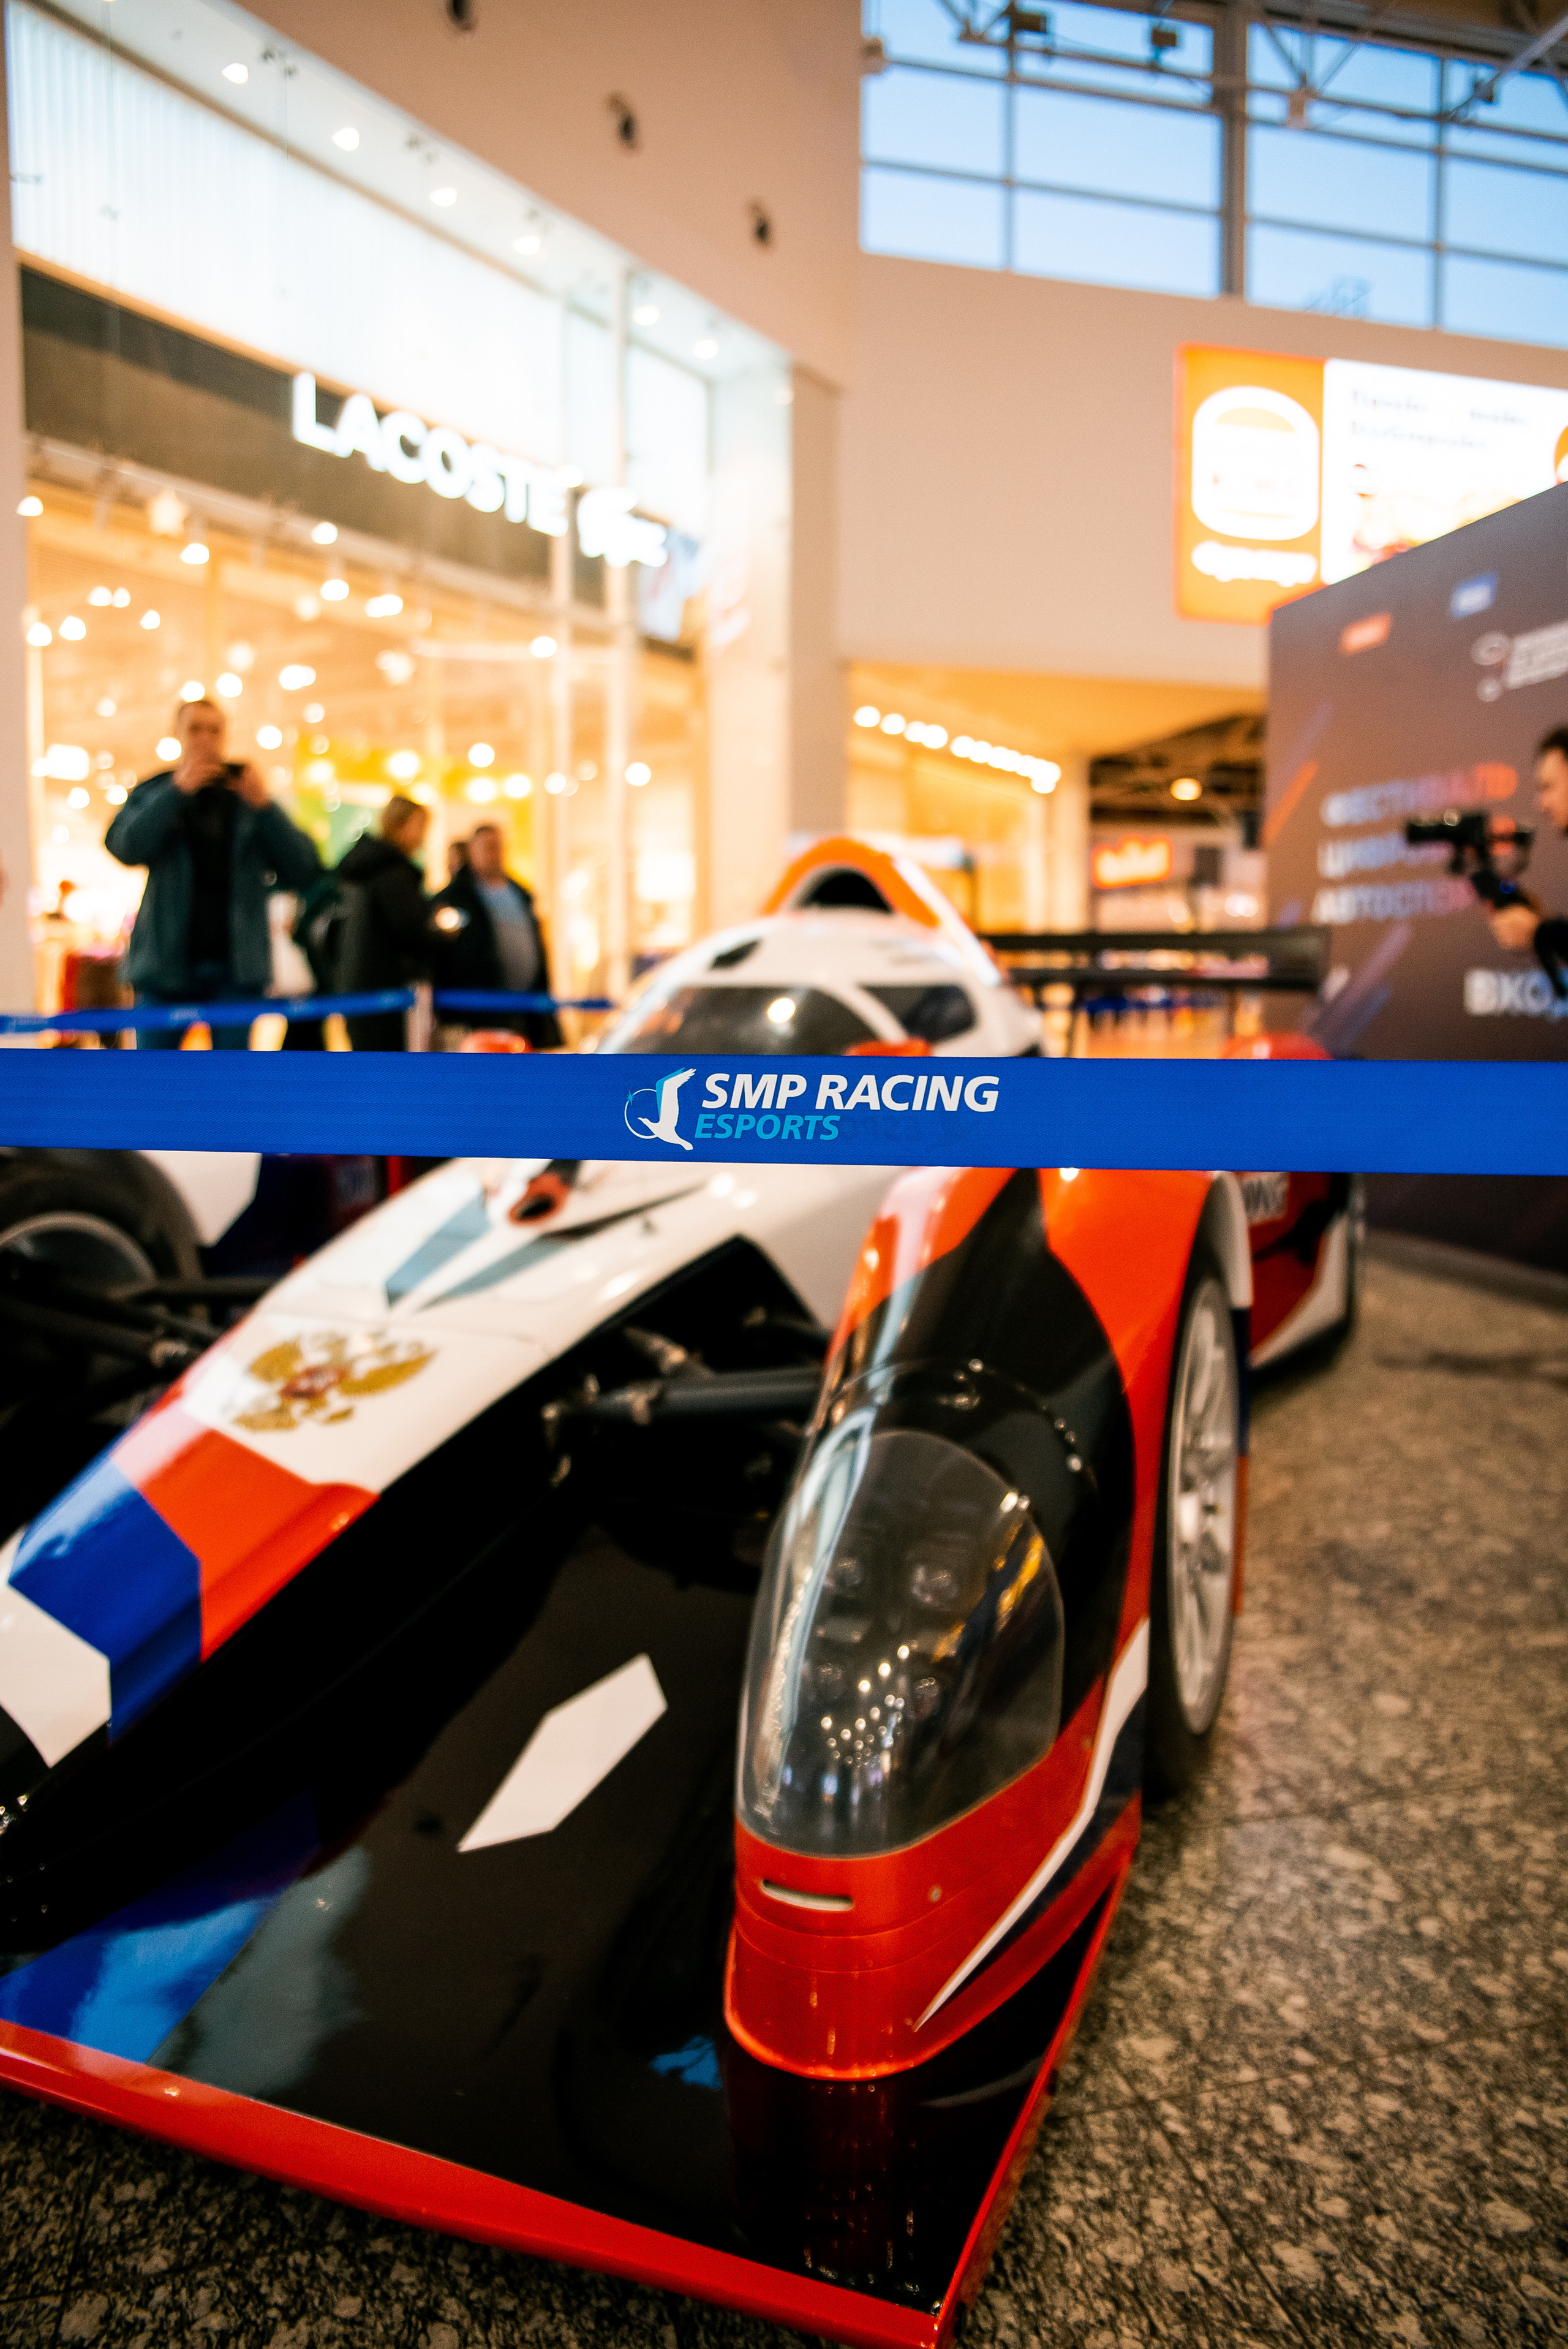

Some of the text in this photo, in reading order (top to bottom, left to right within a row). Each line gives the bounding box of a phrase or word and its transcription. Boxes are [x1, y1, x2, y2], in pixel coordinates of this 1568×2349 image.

[292, 371, 568, 537] LACOSTE
[701, 1073, 1000, 1112] SMP RACING
[694, 1113, 841, 1141] ESPORTS
